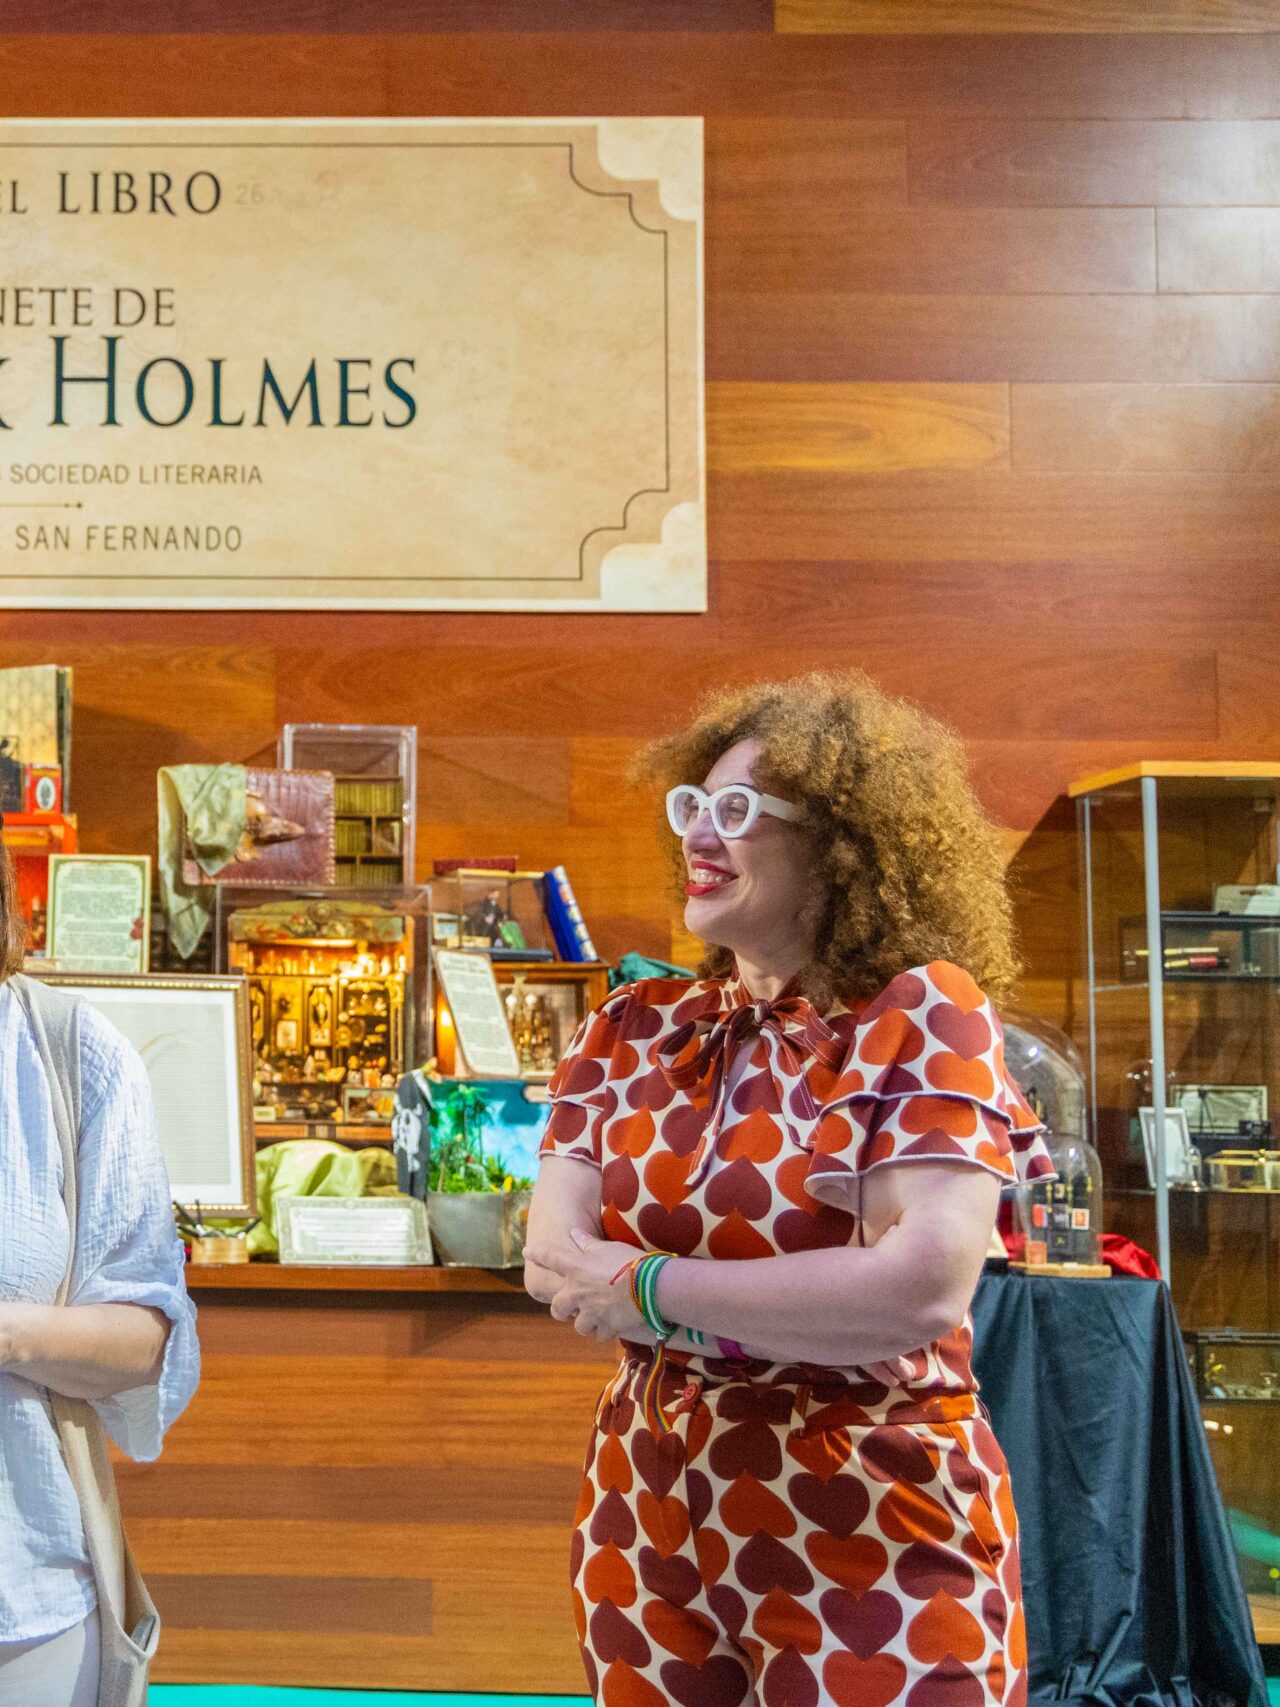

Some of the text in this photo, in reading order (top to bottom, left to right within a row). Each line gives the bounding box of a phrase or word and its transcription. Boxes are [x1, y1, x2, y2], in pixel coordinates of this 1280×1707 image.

[58, 170, 222, 216] LIBRO
[113, 287, 175, 328] DE
[47, 334, 418, 429] HOLMES
[10, 464, 130, 485] SOCIEDAD
[139, 464, 263, 485] LITERARIA
[15, 524, 70, 551] SAN
[86, 525, 242, 552] FERNANDO
